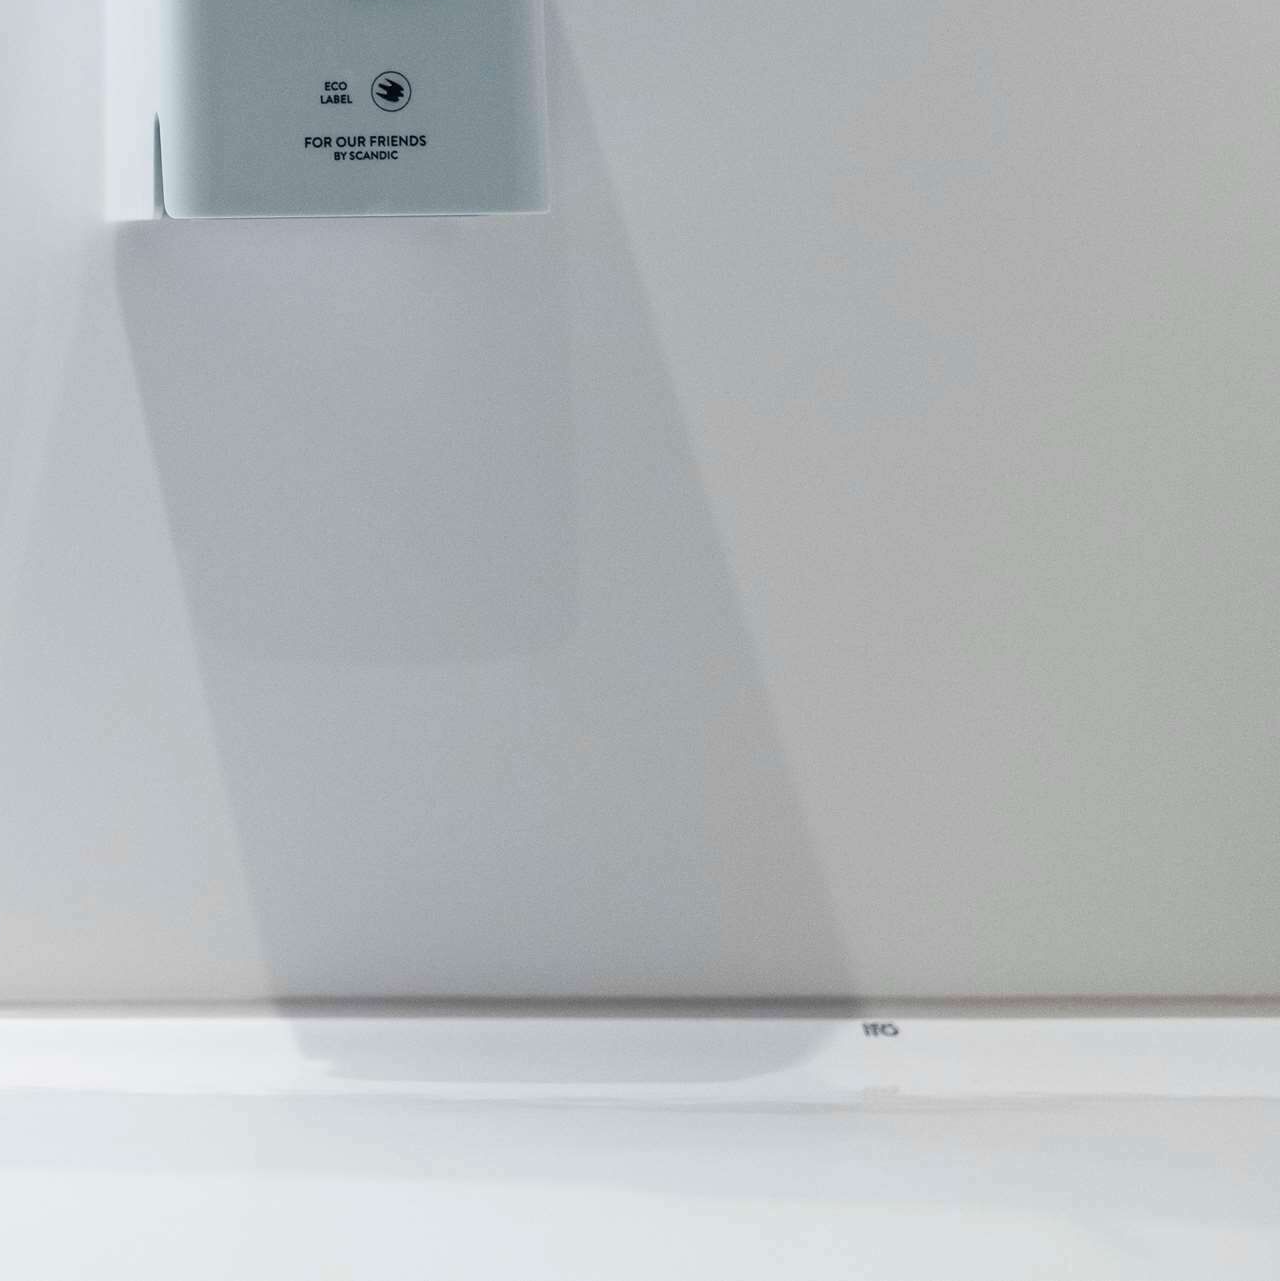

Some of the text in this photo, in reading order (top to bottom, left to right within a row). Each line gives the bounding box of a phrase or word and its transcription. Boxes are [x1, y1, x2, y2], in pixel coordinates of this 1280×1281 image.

[324, 81, 348, 91] ECO
[320, 94, 353, 105] LABEL
[304, 135, 427, 149] FOR OUR FRIENDS
[333, 150, 399, 161] BY SCANDIC
